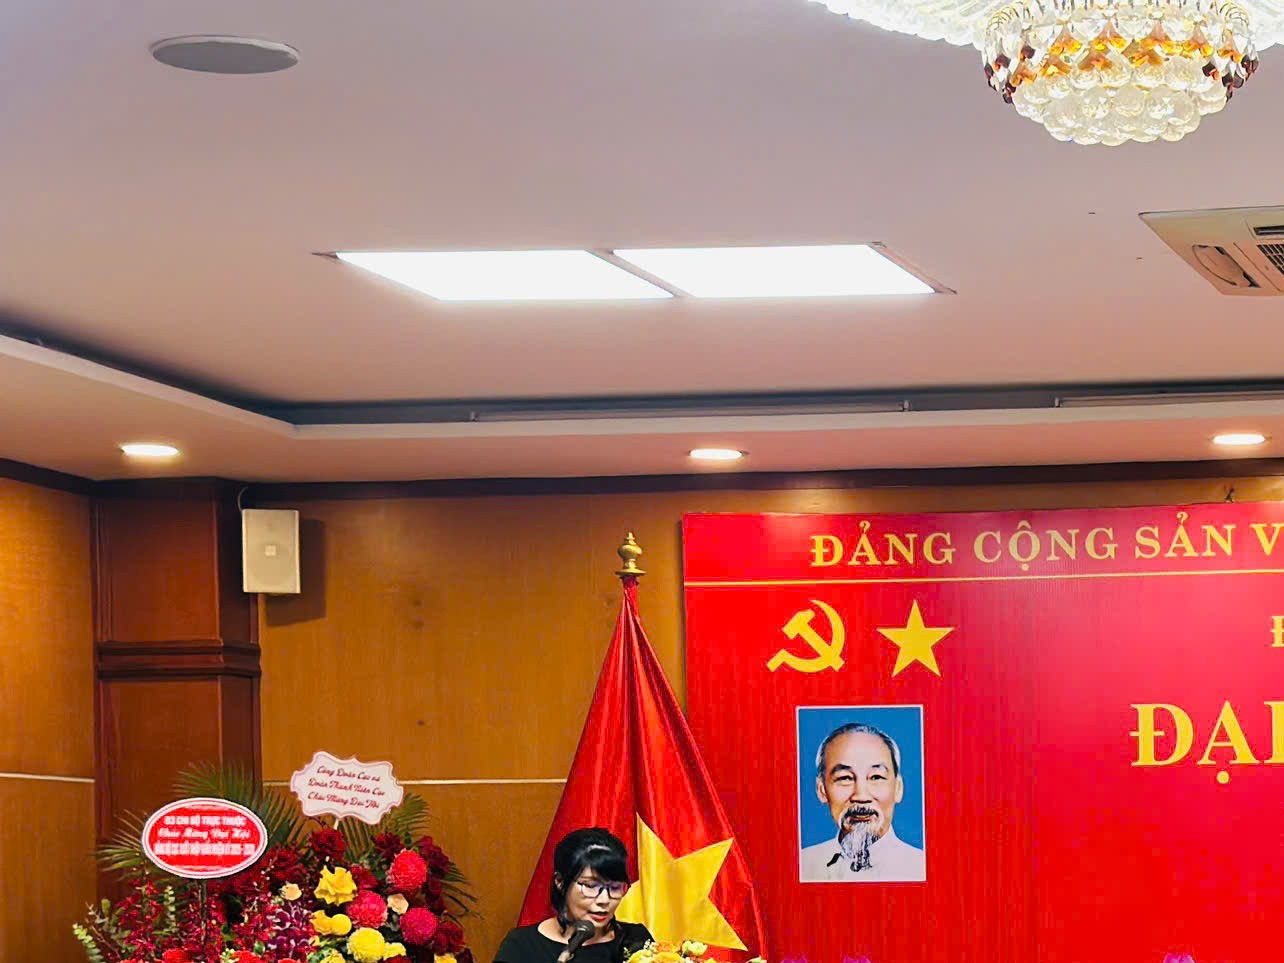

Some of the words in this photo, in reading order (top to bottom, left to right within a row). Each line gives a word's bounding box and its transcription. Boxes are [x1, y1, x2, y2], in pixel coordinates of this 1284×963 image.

[810, 519, 957, 567] ĐẢNG
[973, 520, 1119, 571] CỘNG
[1134, 511, 1236, 560] SẢN
